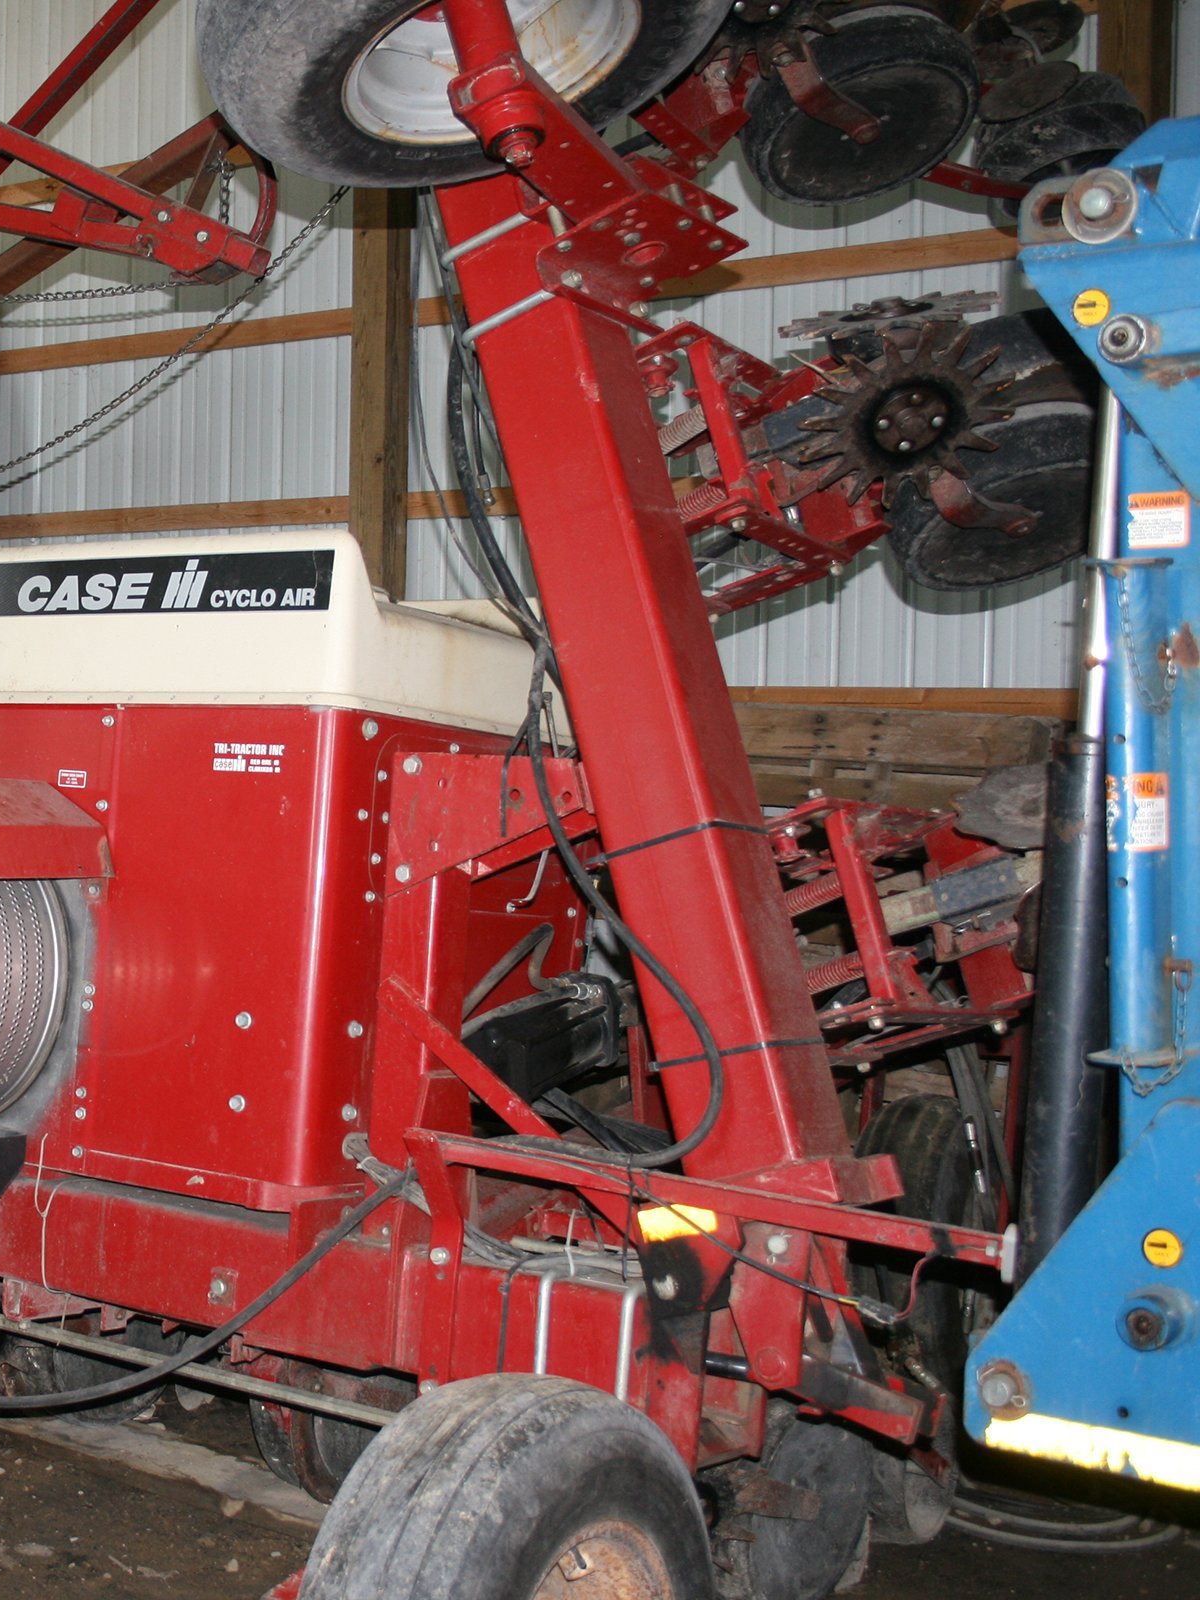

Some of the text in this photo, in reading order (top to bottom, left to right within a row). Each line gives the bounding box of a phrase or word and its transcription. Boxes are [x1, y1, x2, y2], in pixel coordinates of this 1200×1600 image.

[1140, 496, 1184, 507] WARNING
[17, 572, 153, 613] CASE
[210, 588, 277, 608] CYCLO
[281, 588, 316, 607] AIR
[214, 743, 285, 756] TRI-TRACTOR INC
